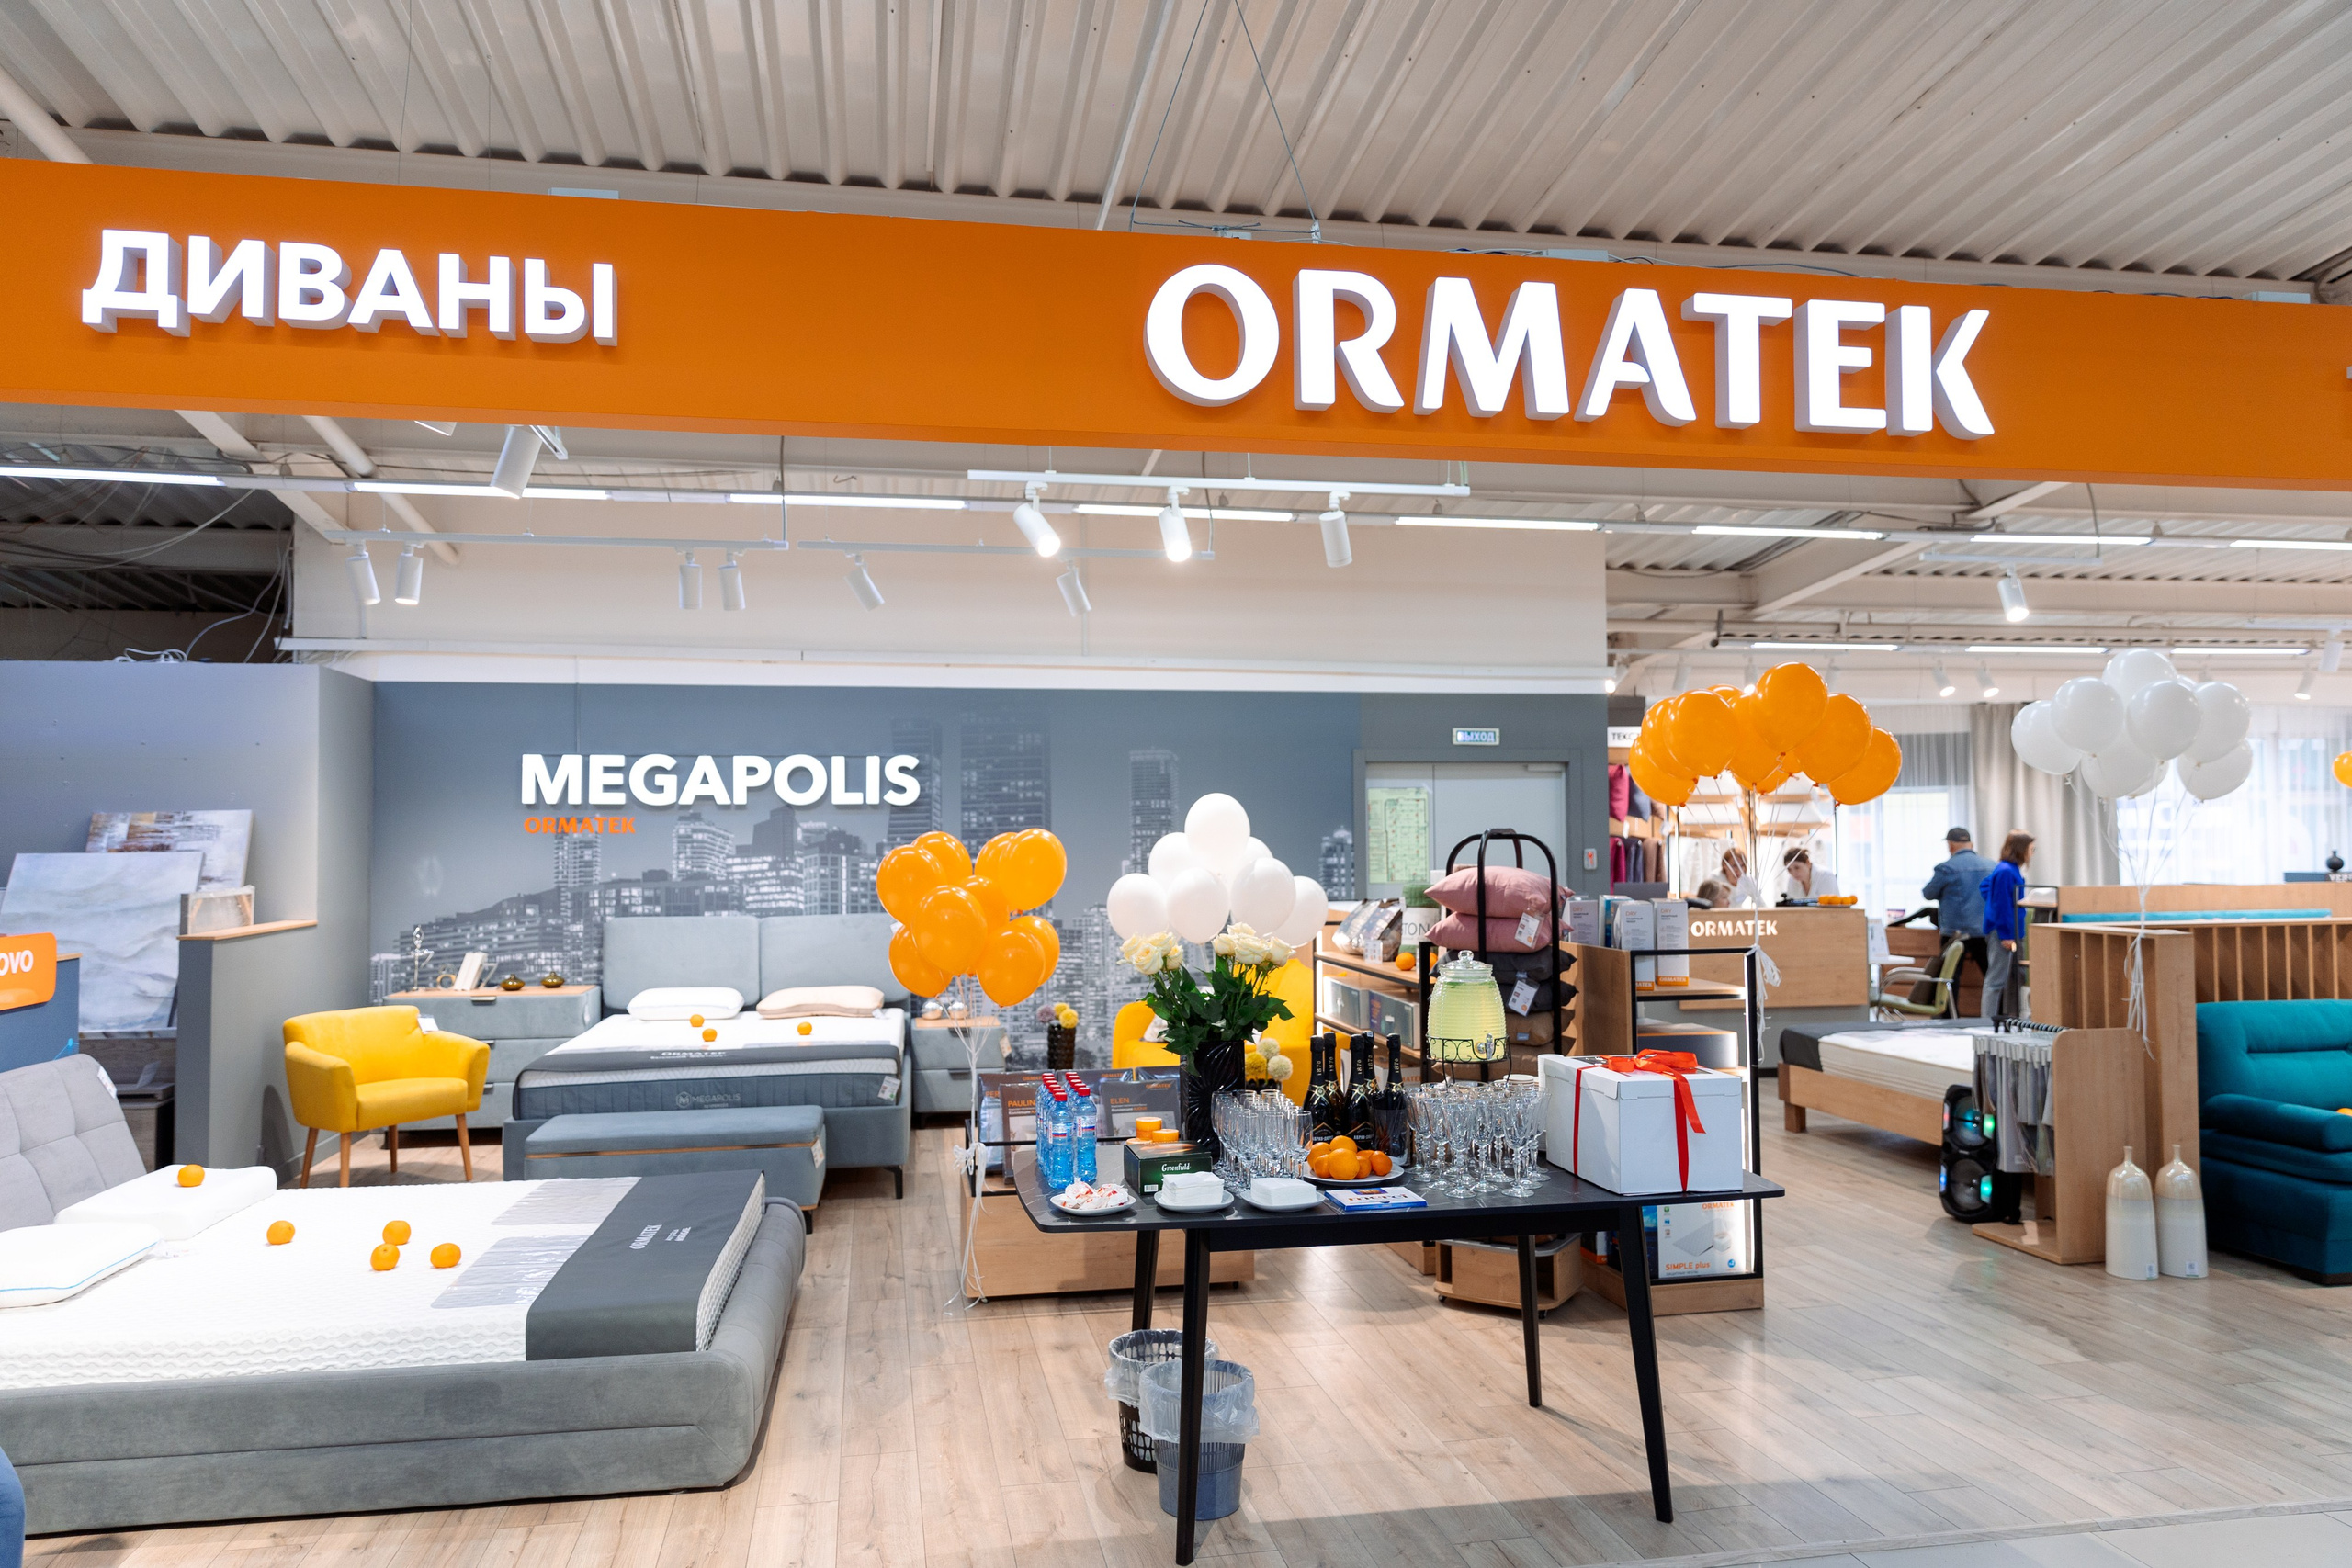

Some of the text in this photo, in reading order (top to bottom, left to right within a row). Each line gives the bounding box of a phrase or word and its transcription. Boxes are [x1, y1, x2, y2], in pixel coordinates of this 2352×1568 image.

[82, 229, 617, 346] ДИВАНЫ
[1143, 264, 1996, 440] ORMATEK
[1457, 730, 1496, 743] ВЫХОД
[521, 753, 922, 807] MEGAPOLIS
[524, 817, 636, 834] ORMATEK
[1690, 920, 1779, 937] ORMATEK
[692, 1093, 741, 1102] MEGAPOLIS
[1161, 1162, 1191, 1172] Greenfield
[1665, 1261, 1711, 1270] SIMPLE plus
